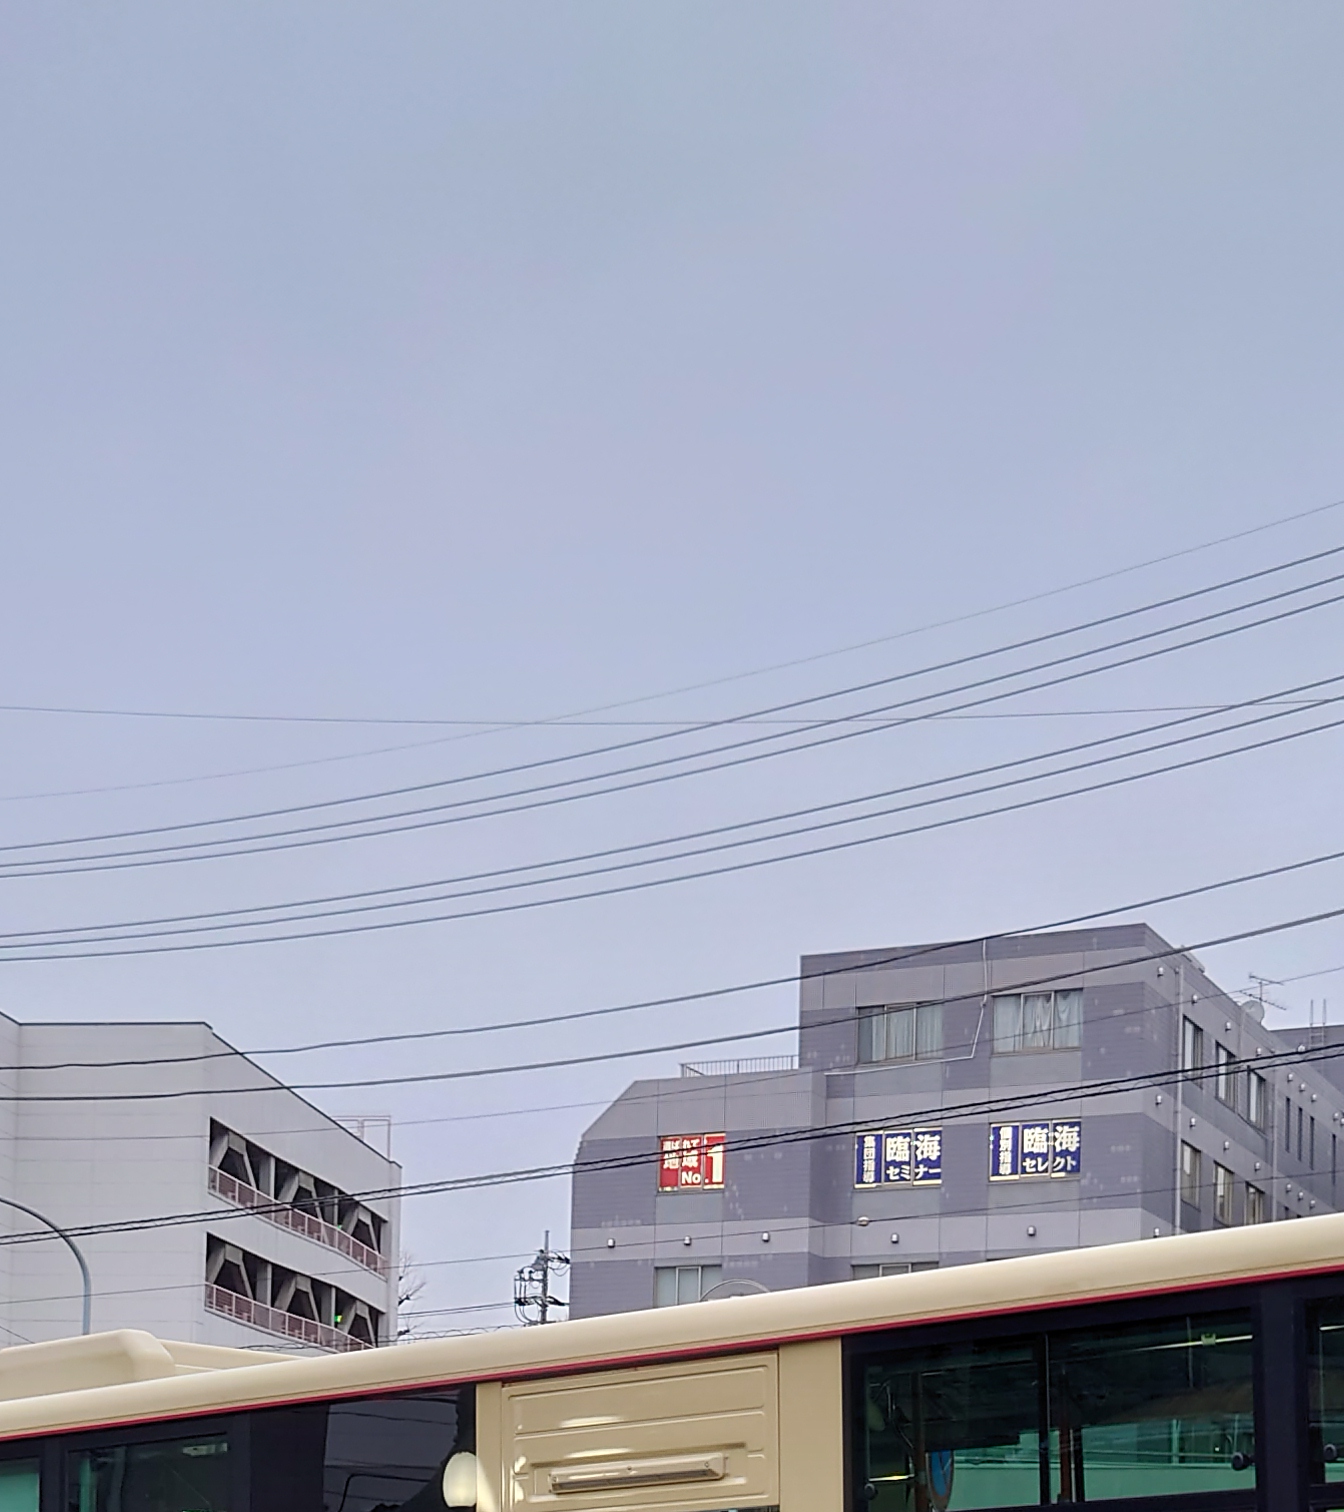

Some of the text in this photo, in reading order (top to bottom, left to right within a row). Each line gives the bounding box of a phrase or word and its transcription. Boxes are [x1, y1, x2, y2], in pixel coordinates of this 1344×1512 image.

[885, 1134, 941, 1162] 臨海
[1023, 1125, 1080, 1153] 臨海
[885, 1164, 942, 1180] セミナー
[1022, 1155, 1077, 1173] セレクト
